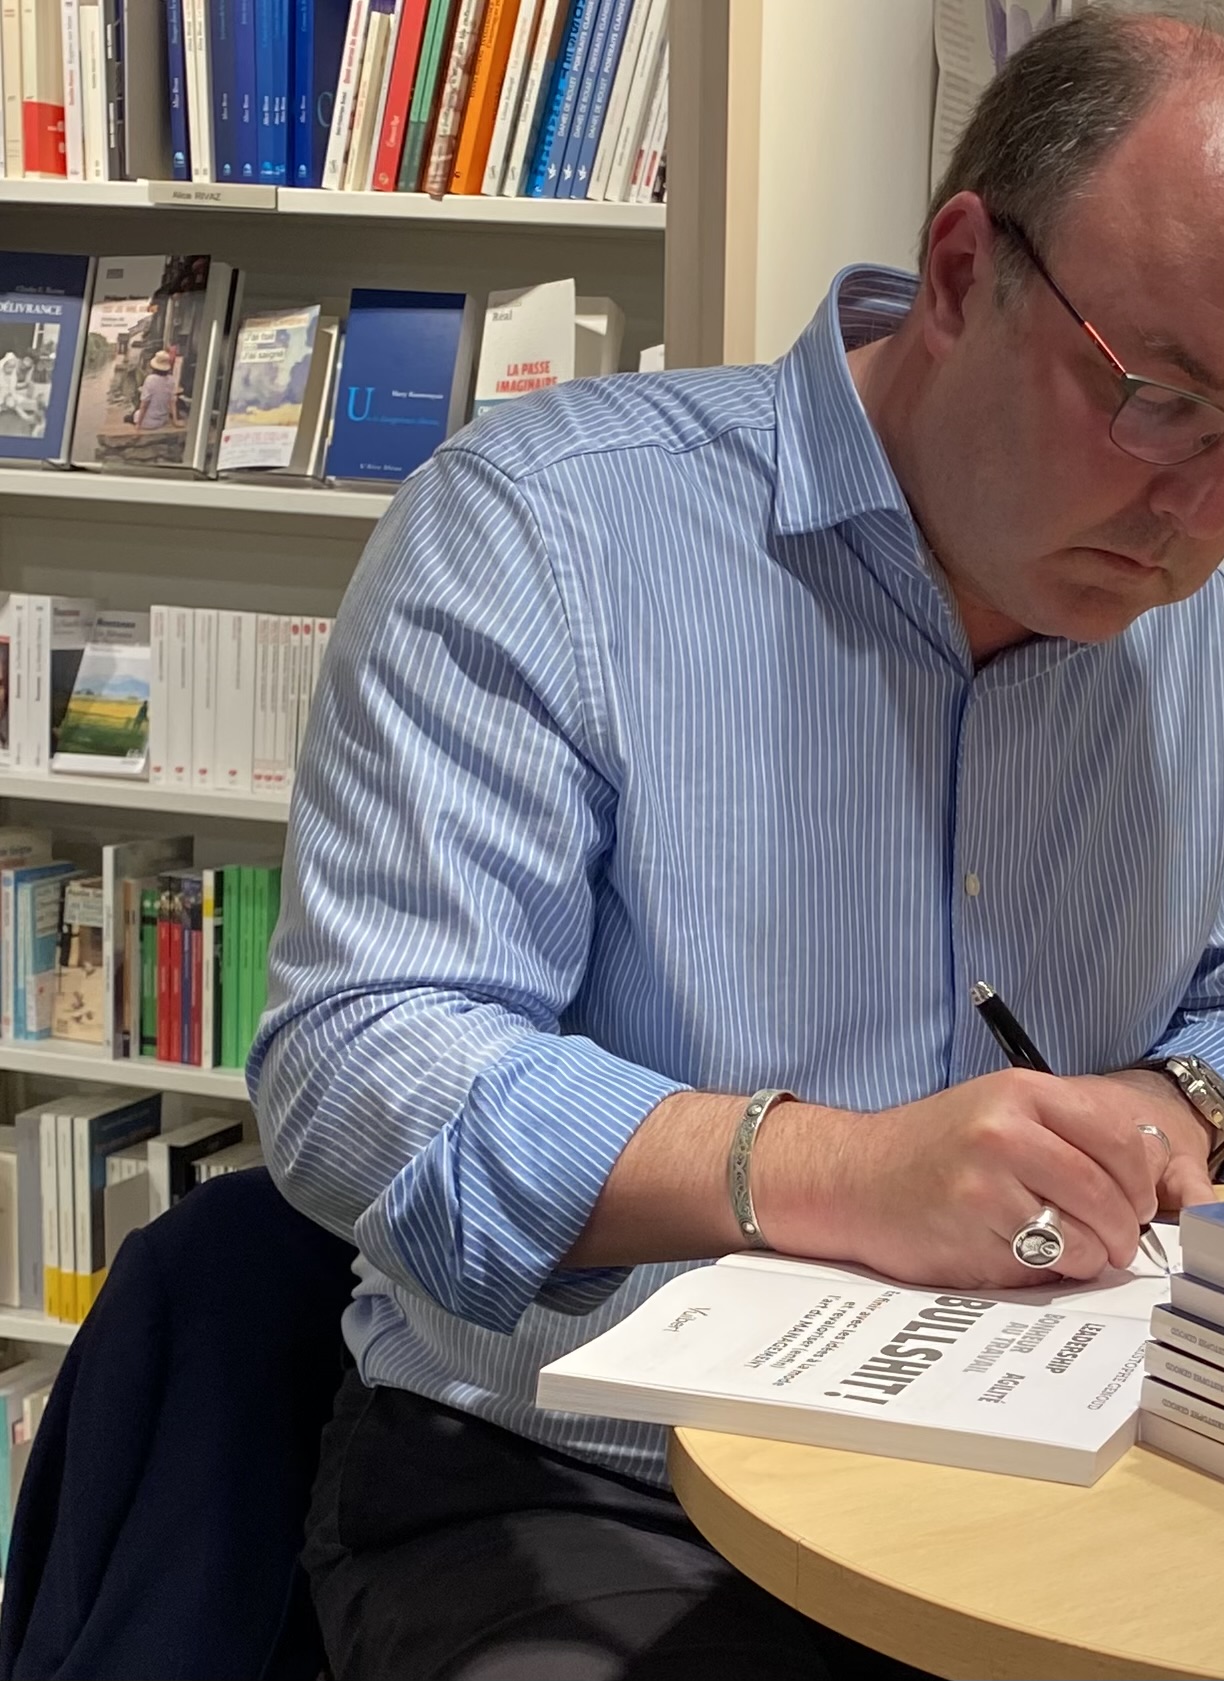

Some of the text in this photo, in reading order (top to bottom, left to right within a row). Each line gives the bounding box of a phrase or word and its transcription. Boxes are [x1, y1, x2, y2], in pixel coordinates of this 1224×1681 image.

[507, 361, 550, 376] LA PASSE
[663, 1306, 711, 1333] Vuibert
[800, 1308, 846, 1348] revaloriser
[804, 1309, 822, 1320] du
[846, 1311, 871, 1329] avec
[745, 1319, 812, 1369] MANAGEMENT
[835, 1329, 856, 1340] les
[962, 1321, 1021, 1374] AU TRAVAIL
[1010, 1313, 1066, 1355] BONHEUR
[1045, 1322, 1106, 1375] LEADERSHIP
[772, 1369, 802, 1386] mode
[977, 1372, 1026, 1405] AGILITÉ
[1087, 1383, 1121, 1410] GENOUD
